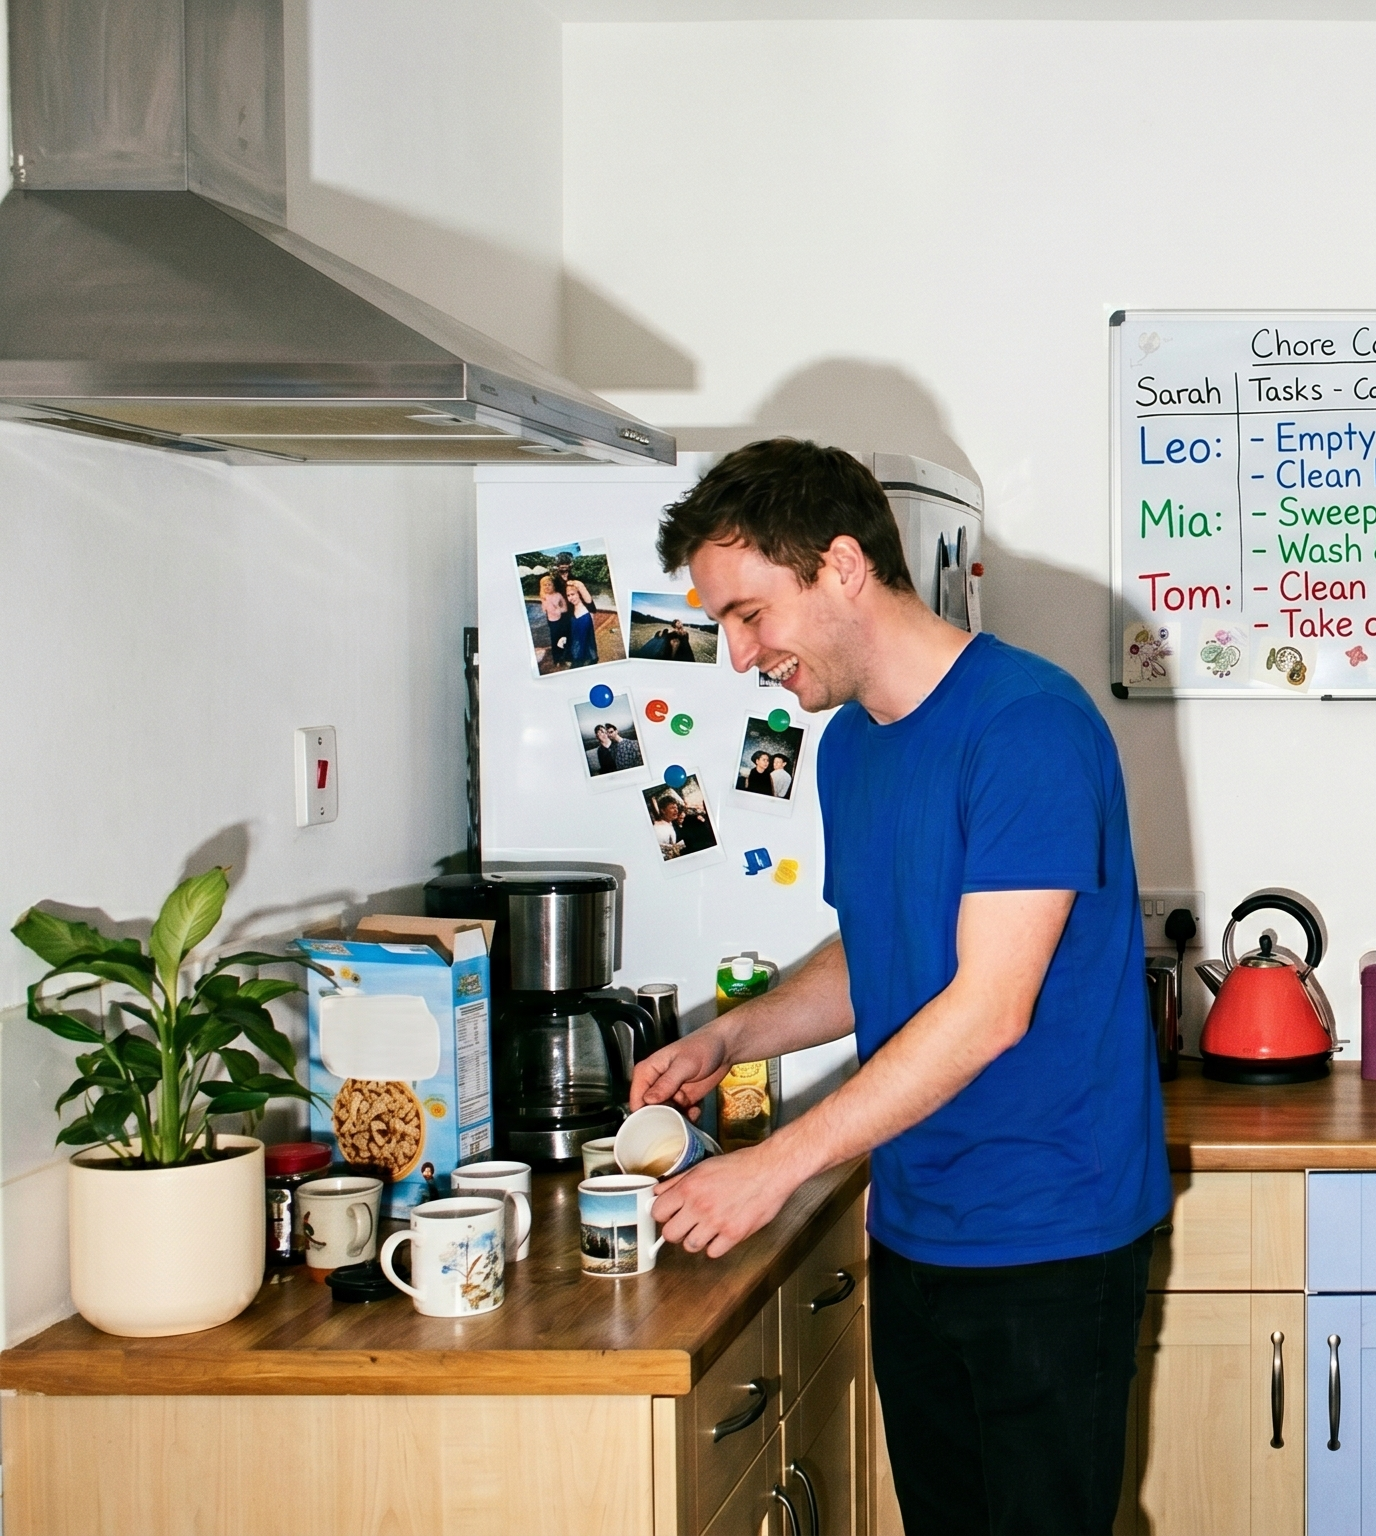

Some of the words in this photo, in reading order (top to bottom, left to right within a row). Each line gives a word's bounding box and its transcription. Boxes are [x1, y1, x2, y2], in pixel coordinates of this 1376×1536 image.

[1251, 328, 1336, 359] Chore
[1135, 375, 1222, 407] Sarah
[1248, 376, 1323, 402] Tasks
[1140, 425, 1222, 465] Leo:
[1276, 421, 1376, 461] Empty
[1276, 460, 1361, 489] Clean
[1141, 498, 1222, 539] Mia:
[1277, 533, 1362, 564] Wash
[1138, 572, 1231, 612] Tom:
[1279, 570, 1366, 602] Clean
[1279, 607, 1353, 639] Take
[645, 699, 669, 723] e
[670, 713, 694, 736] e
